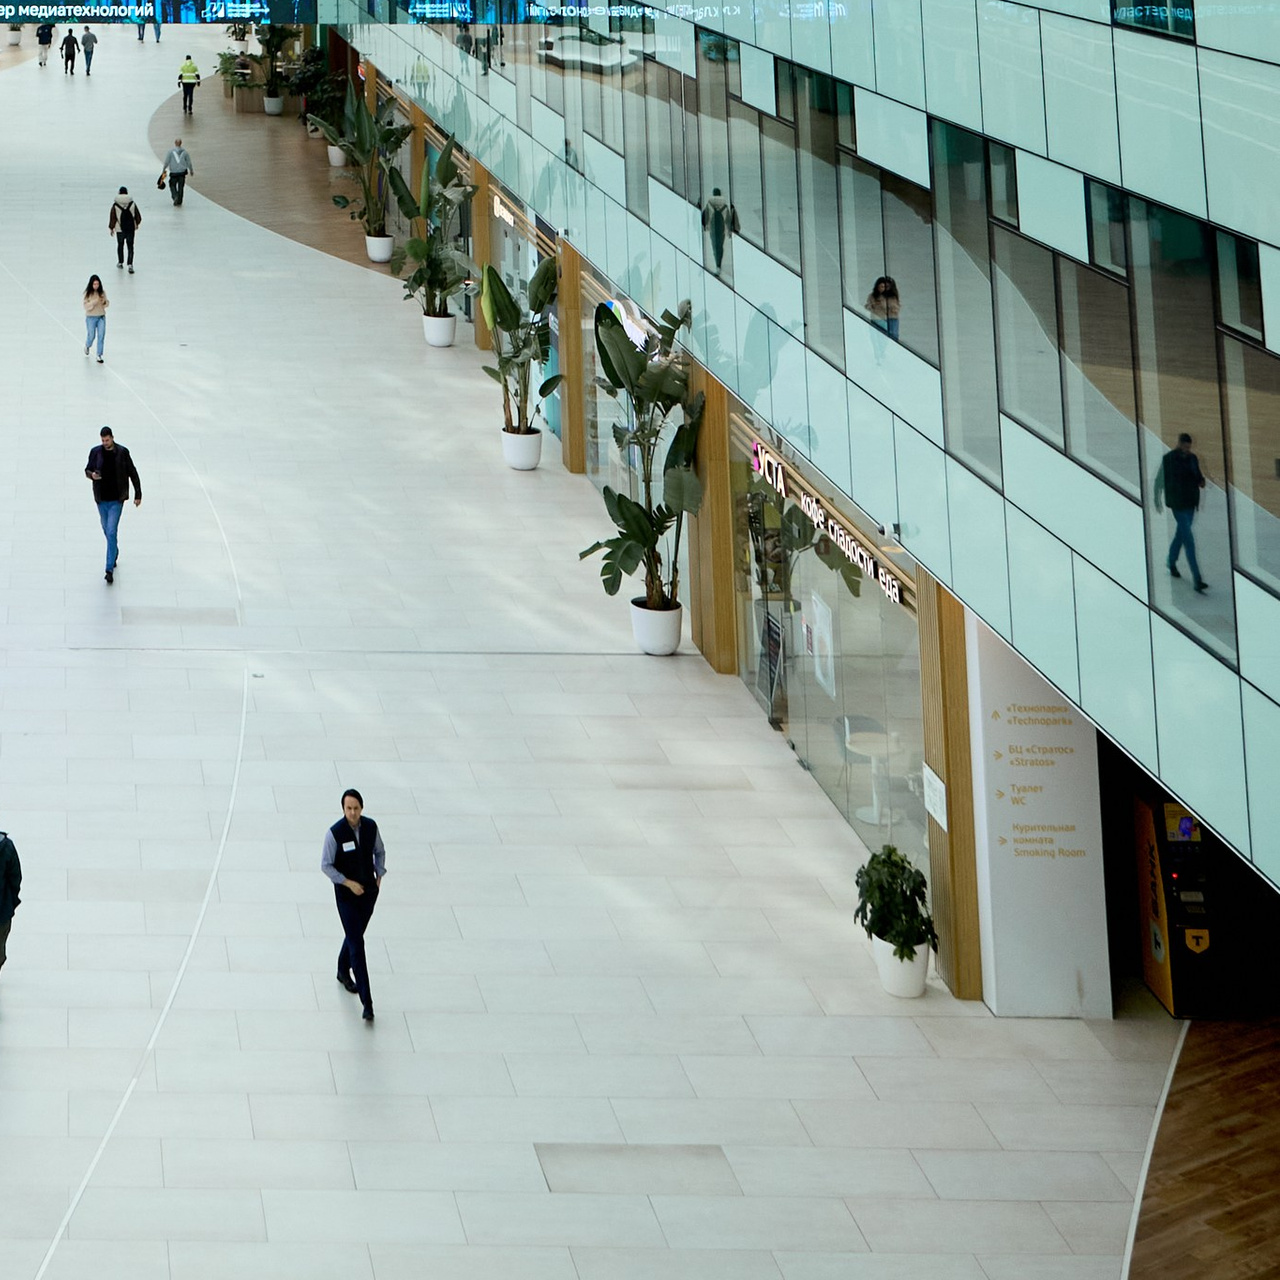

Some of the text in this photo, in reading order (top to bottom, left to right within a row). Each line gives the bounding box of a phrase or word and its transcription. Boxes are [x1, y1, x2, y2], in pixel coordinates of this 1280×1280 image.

[18, 3, 154, 19] медиатехнологий
[800, 491, 901, 603] кофе сладости еда
[1025, 745, 1076, 756] «Стратос»
[1009, 757, 1057, 767] «Stratos»
[1010, 784, 1044, 795] Туалет
[1011, 796, 1027, 805] WC
[1012, 823, 1076, 834] Курительная
[1013, 836, 1055, 845] комната
[1014, 848, 1087, 860] Smoking Room
